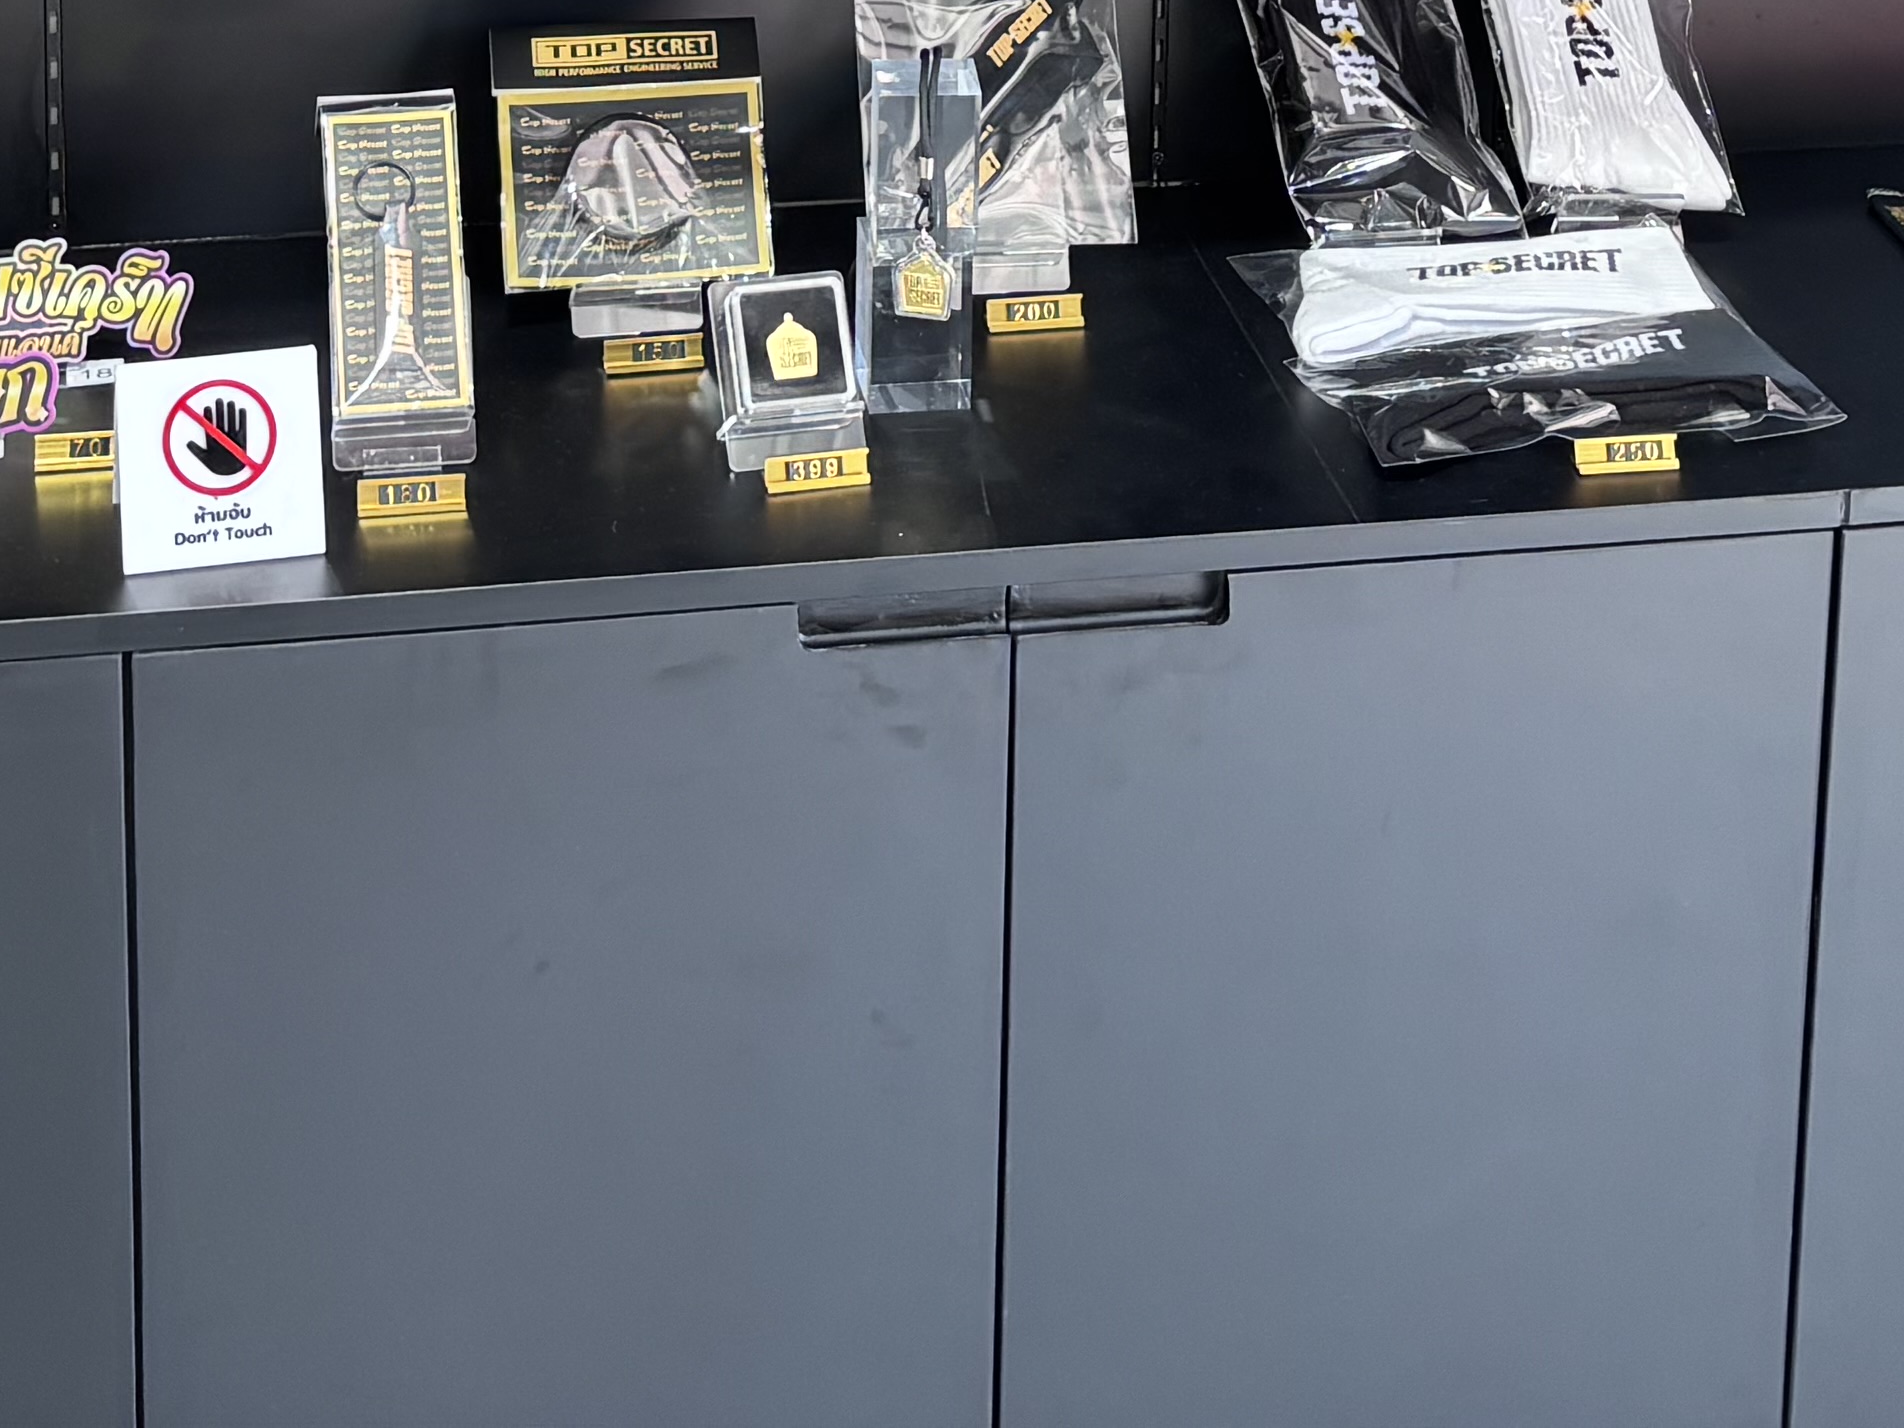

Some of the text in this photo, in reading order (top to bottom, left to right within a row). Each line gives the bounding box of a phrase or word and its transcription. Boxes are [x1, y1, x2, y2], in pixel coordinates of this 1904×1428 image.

[544, 36, 709, 59] TOP SECRET
[1484, 247, 1624, 276] SECRET
[1012, 301, 1056, 322] 200
[80, 366, 112, 380] 18
[73, 438, 101, 458] 70
[793, 457, 839, 481] 399
[194, 502, 252, 525] ห้ามจับ
[174, 522, 273, 546] Don't Touch
